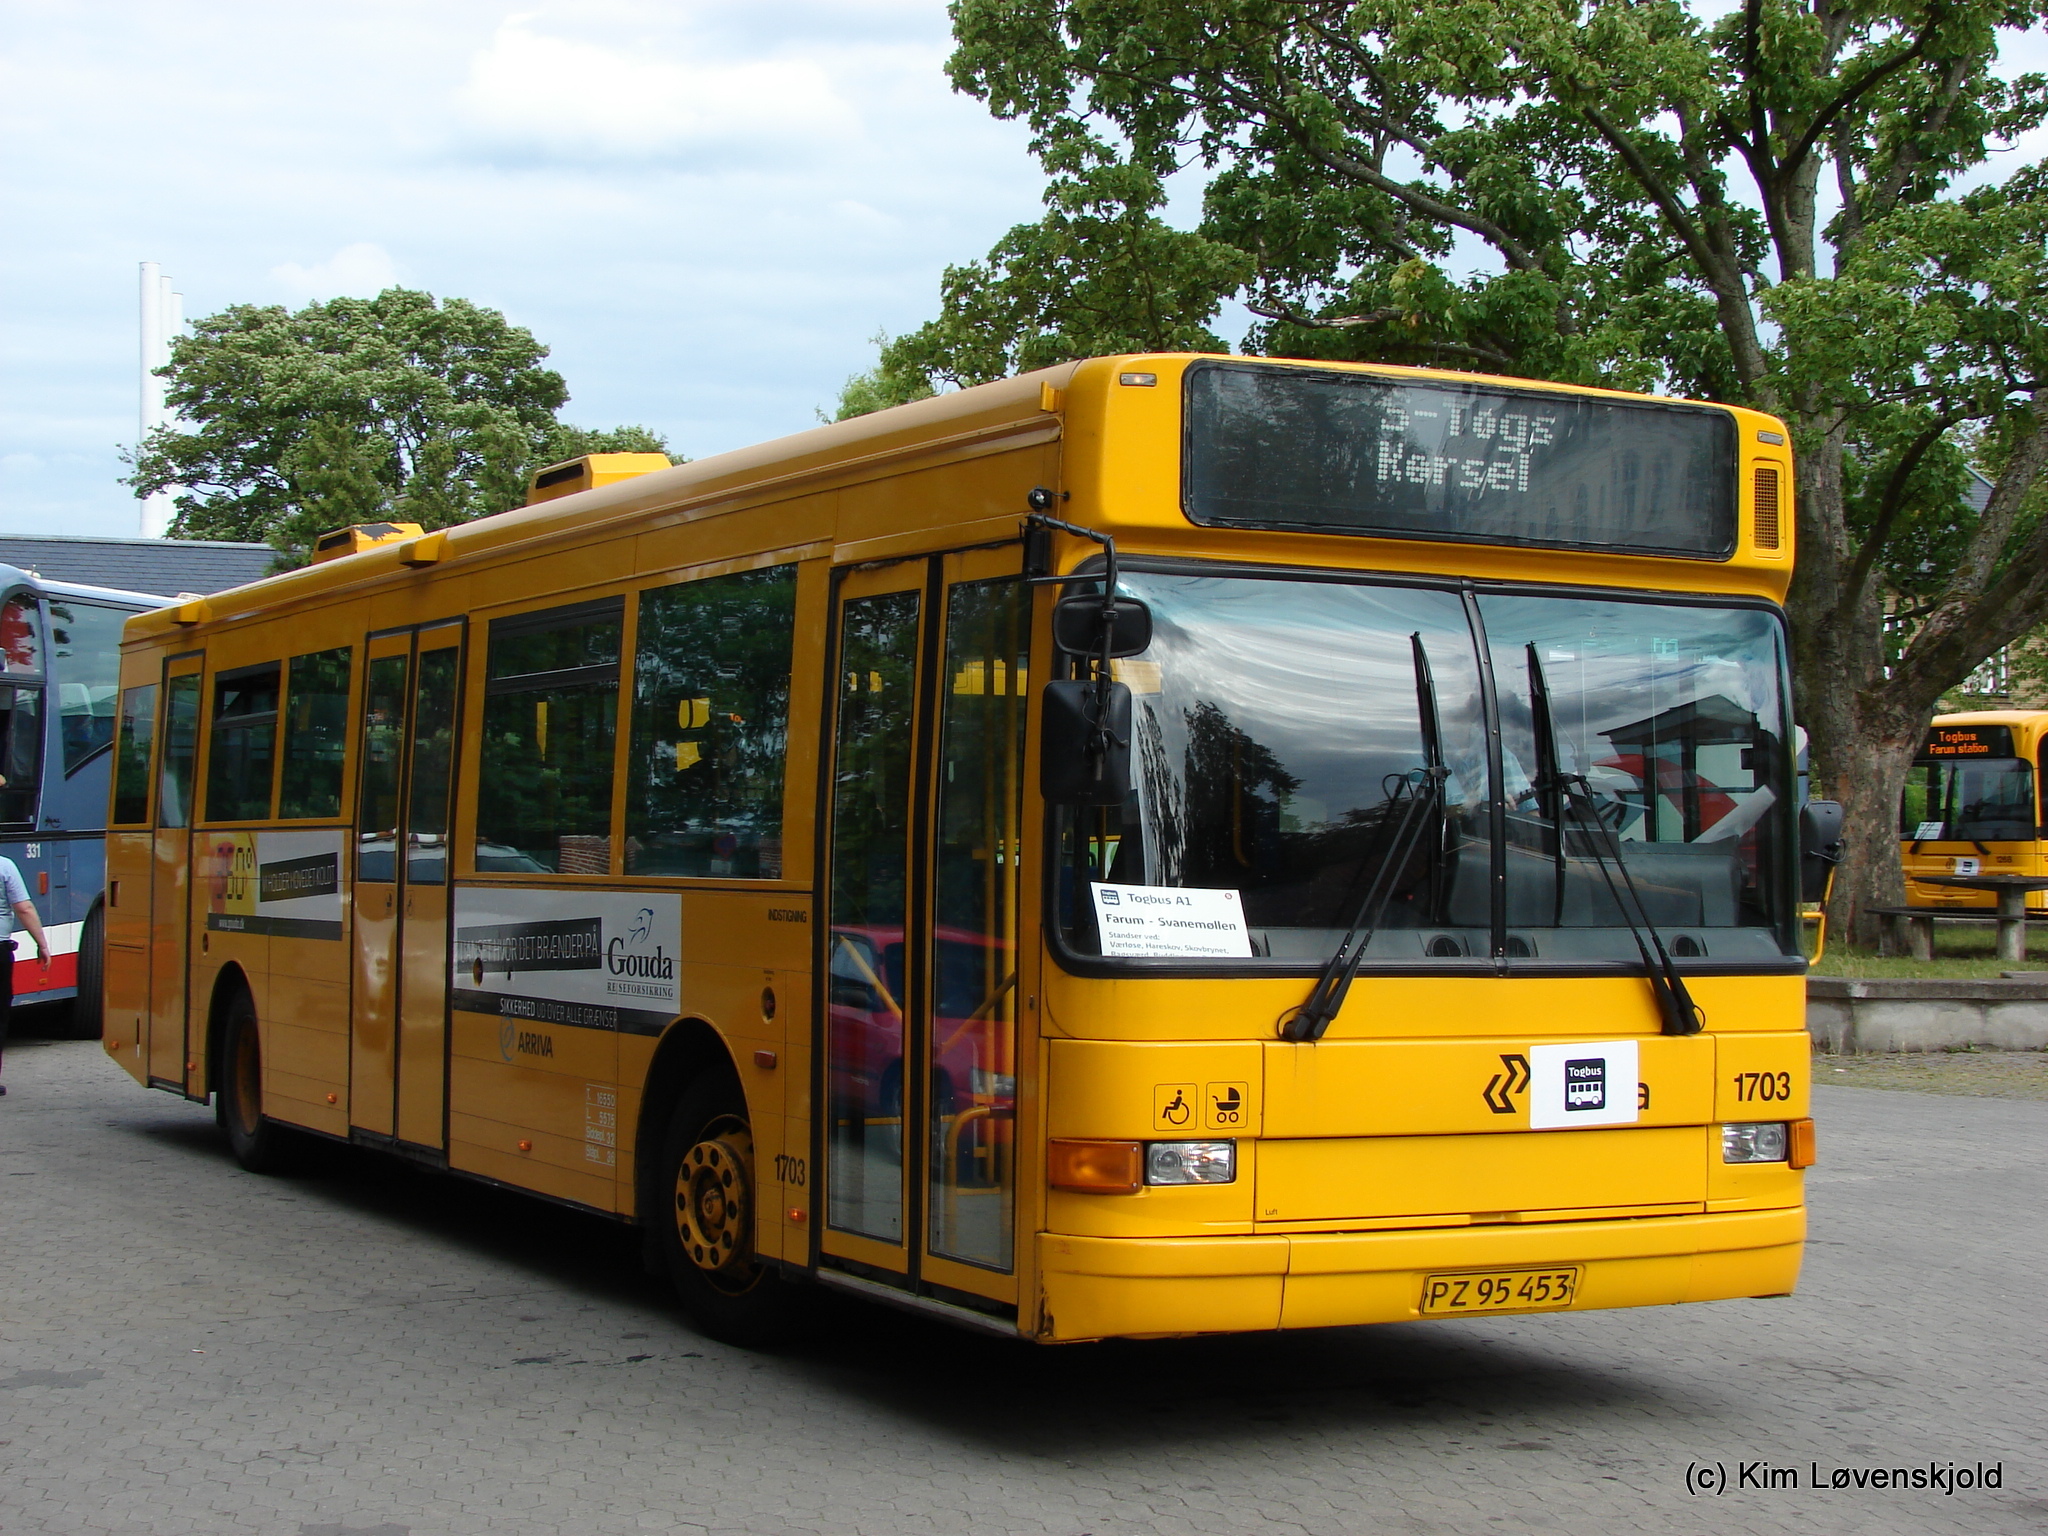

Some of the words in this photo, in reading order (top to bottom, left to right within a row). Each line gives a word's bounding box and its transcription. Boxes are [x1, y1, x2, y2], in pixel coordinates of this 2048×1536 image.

[1378, 440, 1529, 492] Kørsel
[1939, 731, 1977, 743] Togbus
[1929, 743, 1955, 754] Farum
[1957, 742, 1988, 754] station
[26, 843, 41, 859] 331
[1127, 893, 1172, 905] Togbus
[1176, 896, 1192, 906] A1
[768, 909, 807, 923] INDSTIGNING
[1106, 913, 1145, 925] Farum
[1158, 917, 1237, 931] Svanemøllen
[519, 936, 536, 960] DET
[537, 933, 584, 959] BRÆNDER
[585, 924, 599, 957] PÅ
[1108, 931, 1142, 939] Standser
[608, 937, 673, 980] Gouda
[500, 998, 535, 1017] SIKKERHED
[547, 1003, 565, 1021] OVER
[566, 1006, 582, 1024] ALLE
[518, 1031, 553, 1057] ARRIVA
[1568, 1066, 1603, 1078] Togbus
[1734, 1071, 1791, 1102] 1703
[606, 1132, 615, 1145] 32
[774, 1154, 805, 1186] 1703
[1265, 1208, 1278, 1216] Luft
[1429, 1280, 1467, 1308] PZ
[1477, 1277, 1512, 1305] 95
[1517, 1273, 1570, 1303] 453
